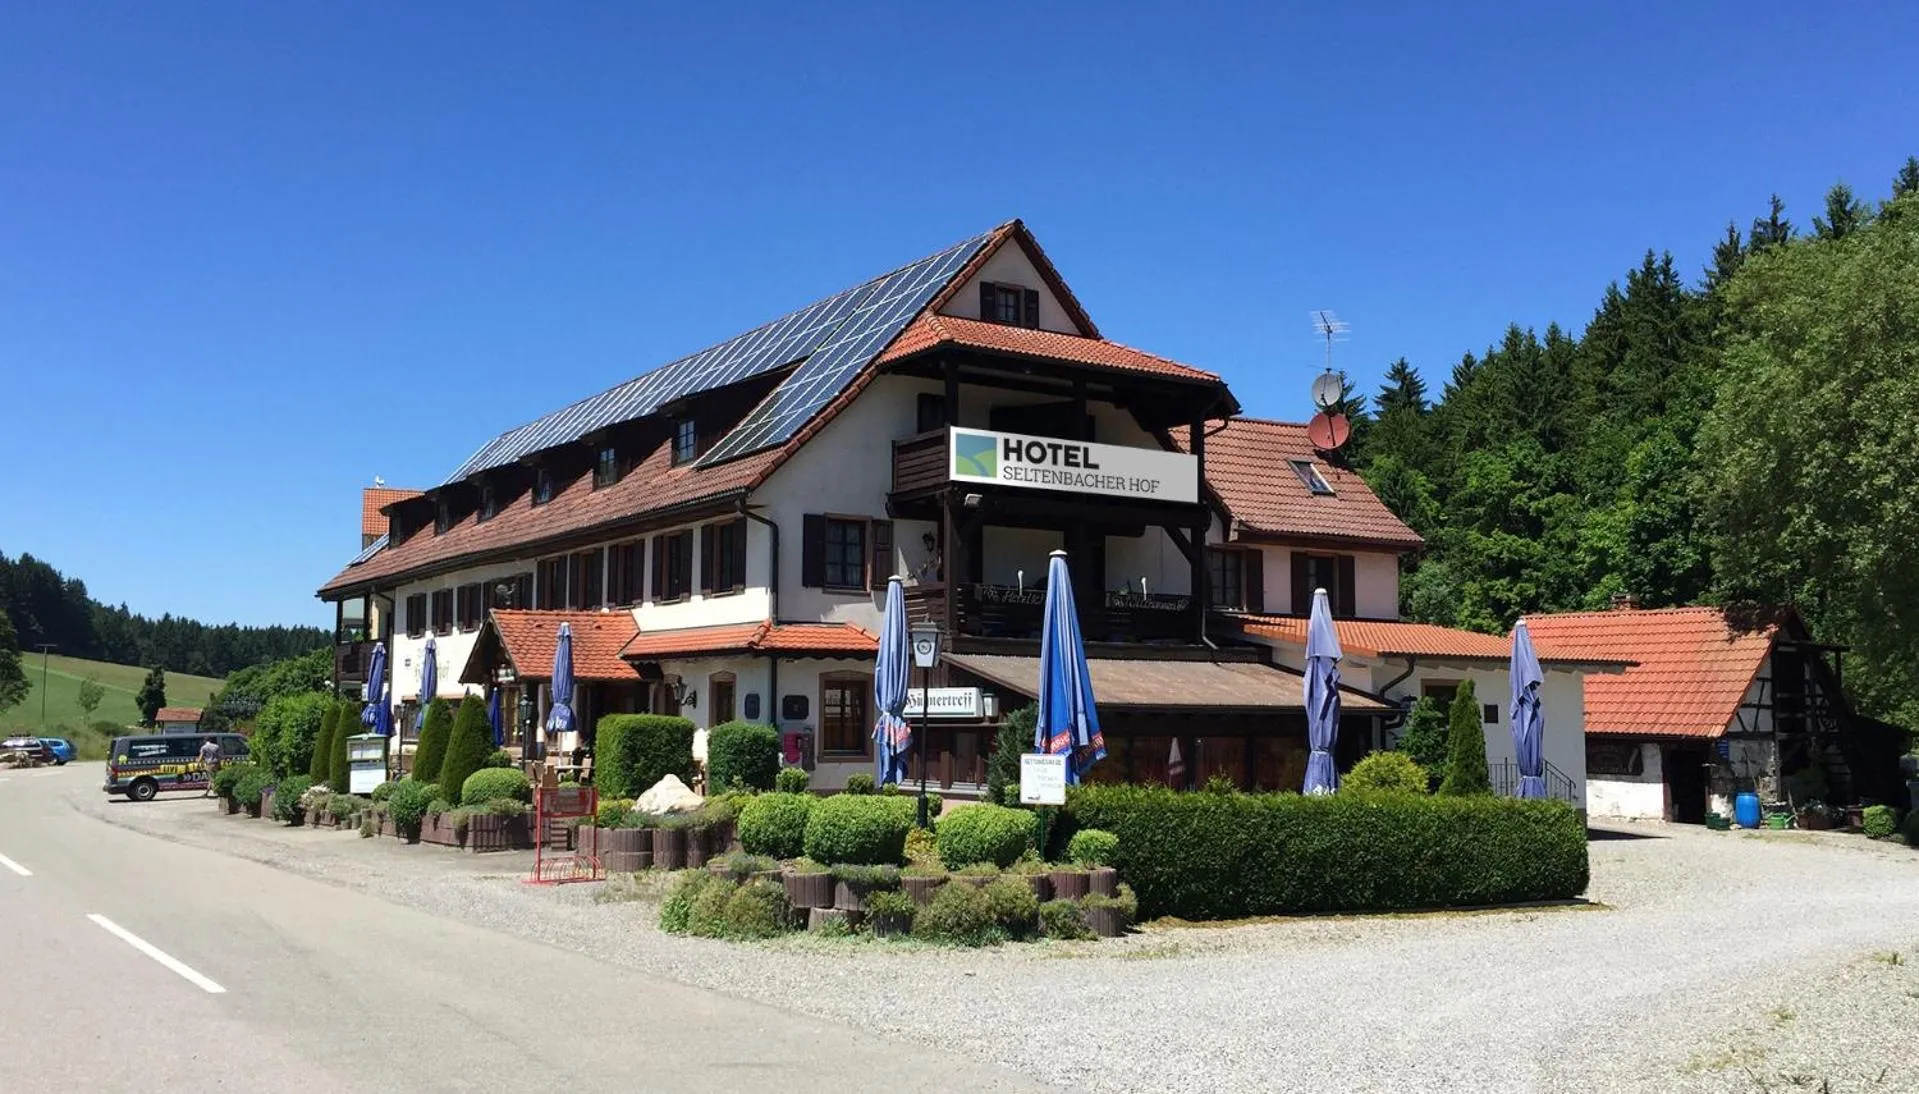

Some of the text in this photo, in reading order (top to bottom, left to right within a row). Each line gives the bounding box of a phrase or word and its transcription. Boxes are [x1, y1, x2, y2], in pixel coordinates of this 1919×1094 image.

[1003, 438, 1099, 470] HOTEL
[1003, 466, 1160, 493] SELTENBACHER HOF
[907, 692, 972, 709] Hünertreff
